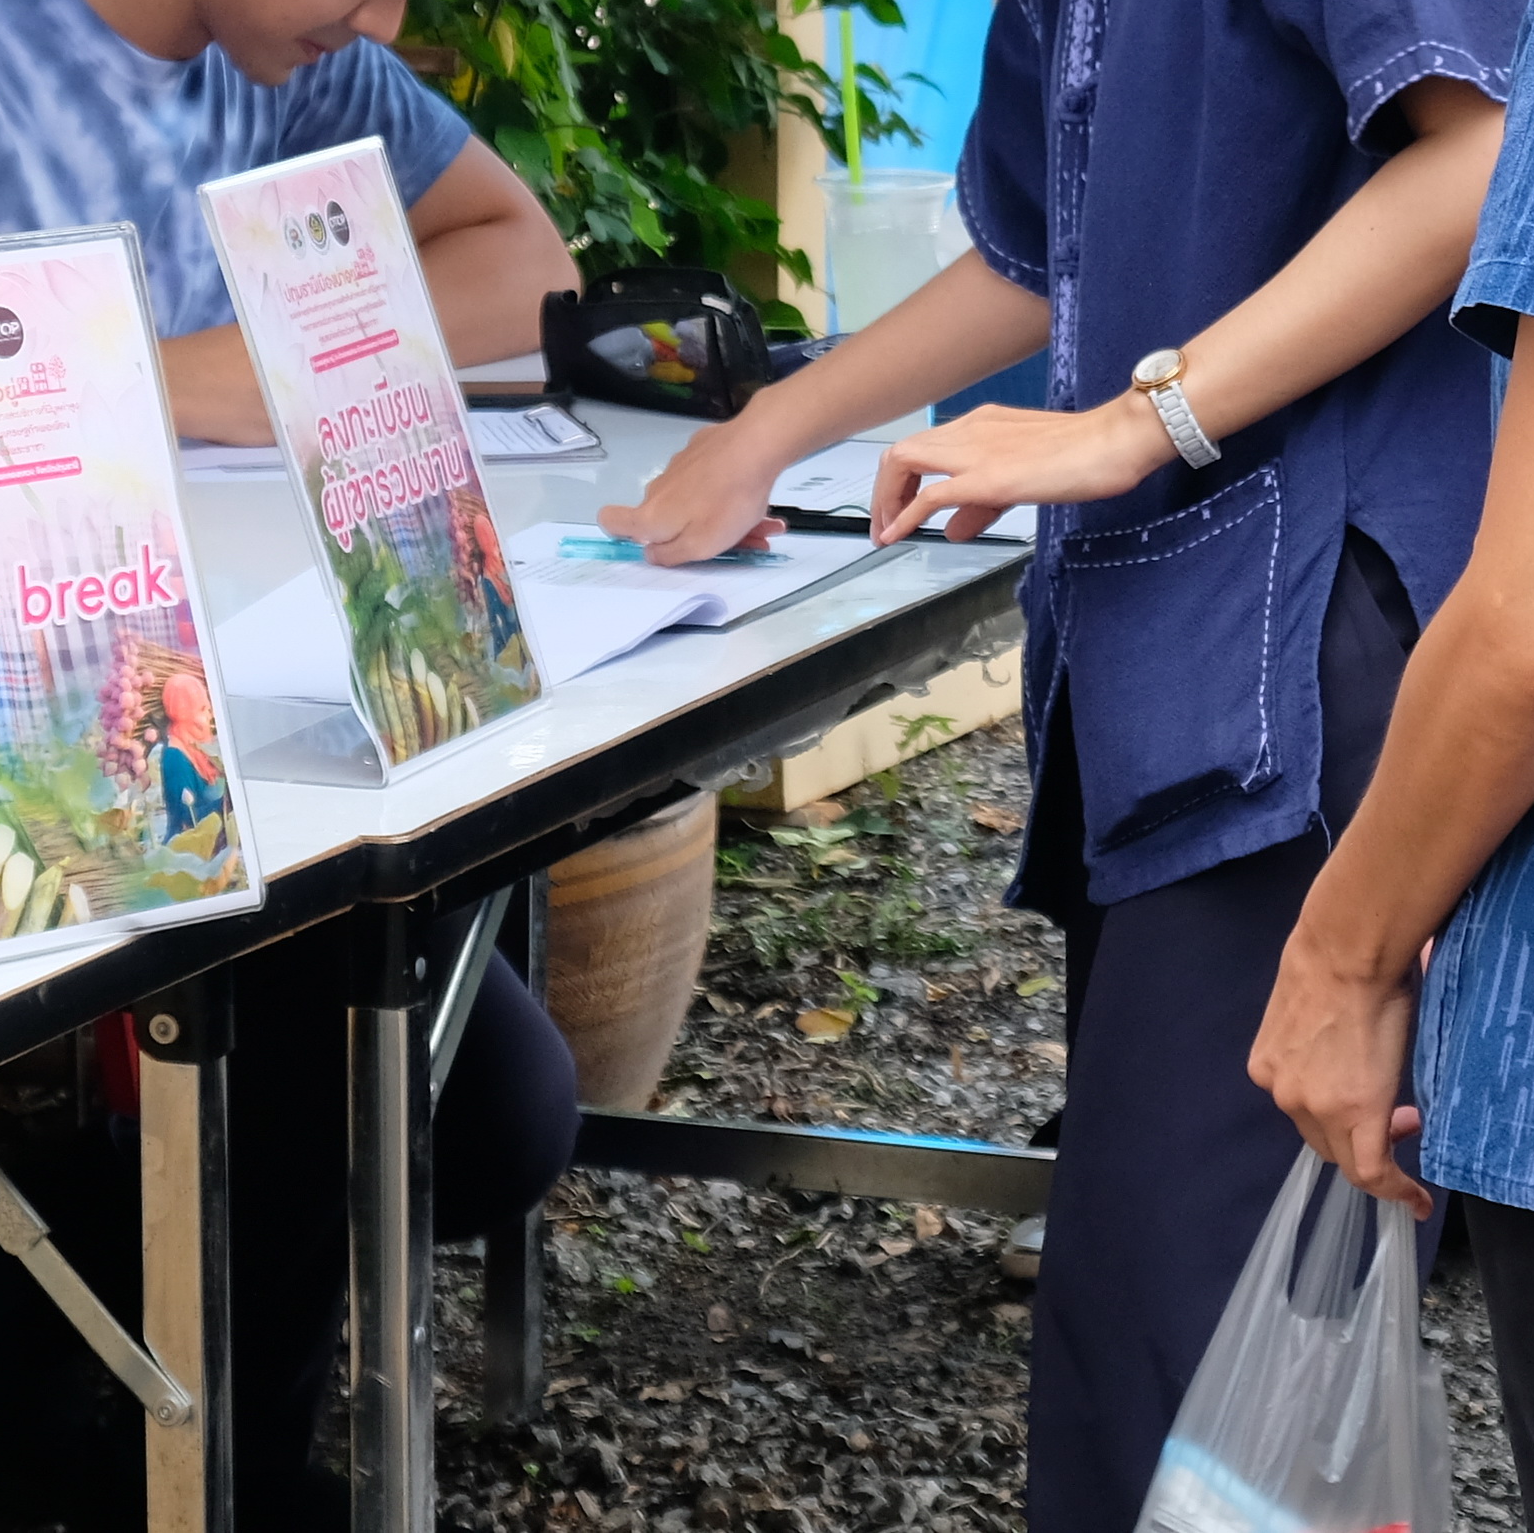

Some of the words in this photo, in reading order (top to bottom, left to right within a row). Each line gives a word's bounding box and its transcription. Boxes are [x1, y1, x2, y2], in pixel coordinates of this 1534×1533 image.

[318, 374, 431, 460] ลงทะเบียน
[323, 441, 465, 549] ผู้เข้าร่วมงาน
[17, 544, 173, 626] break
